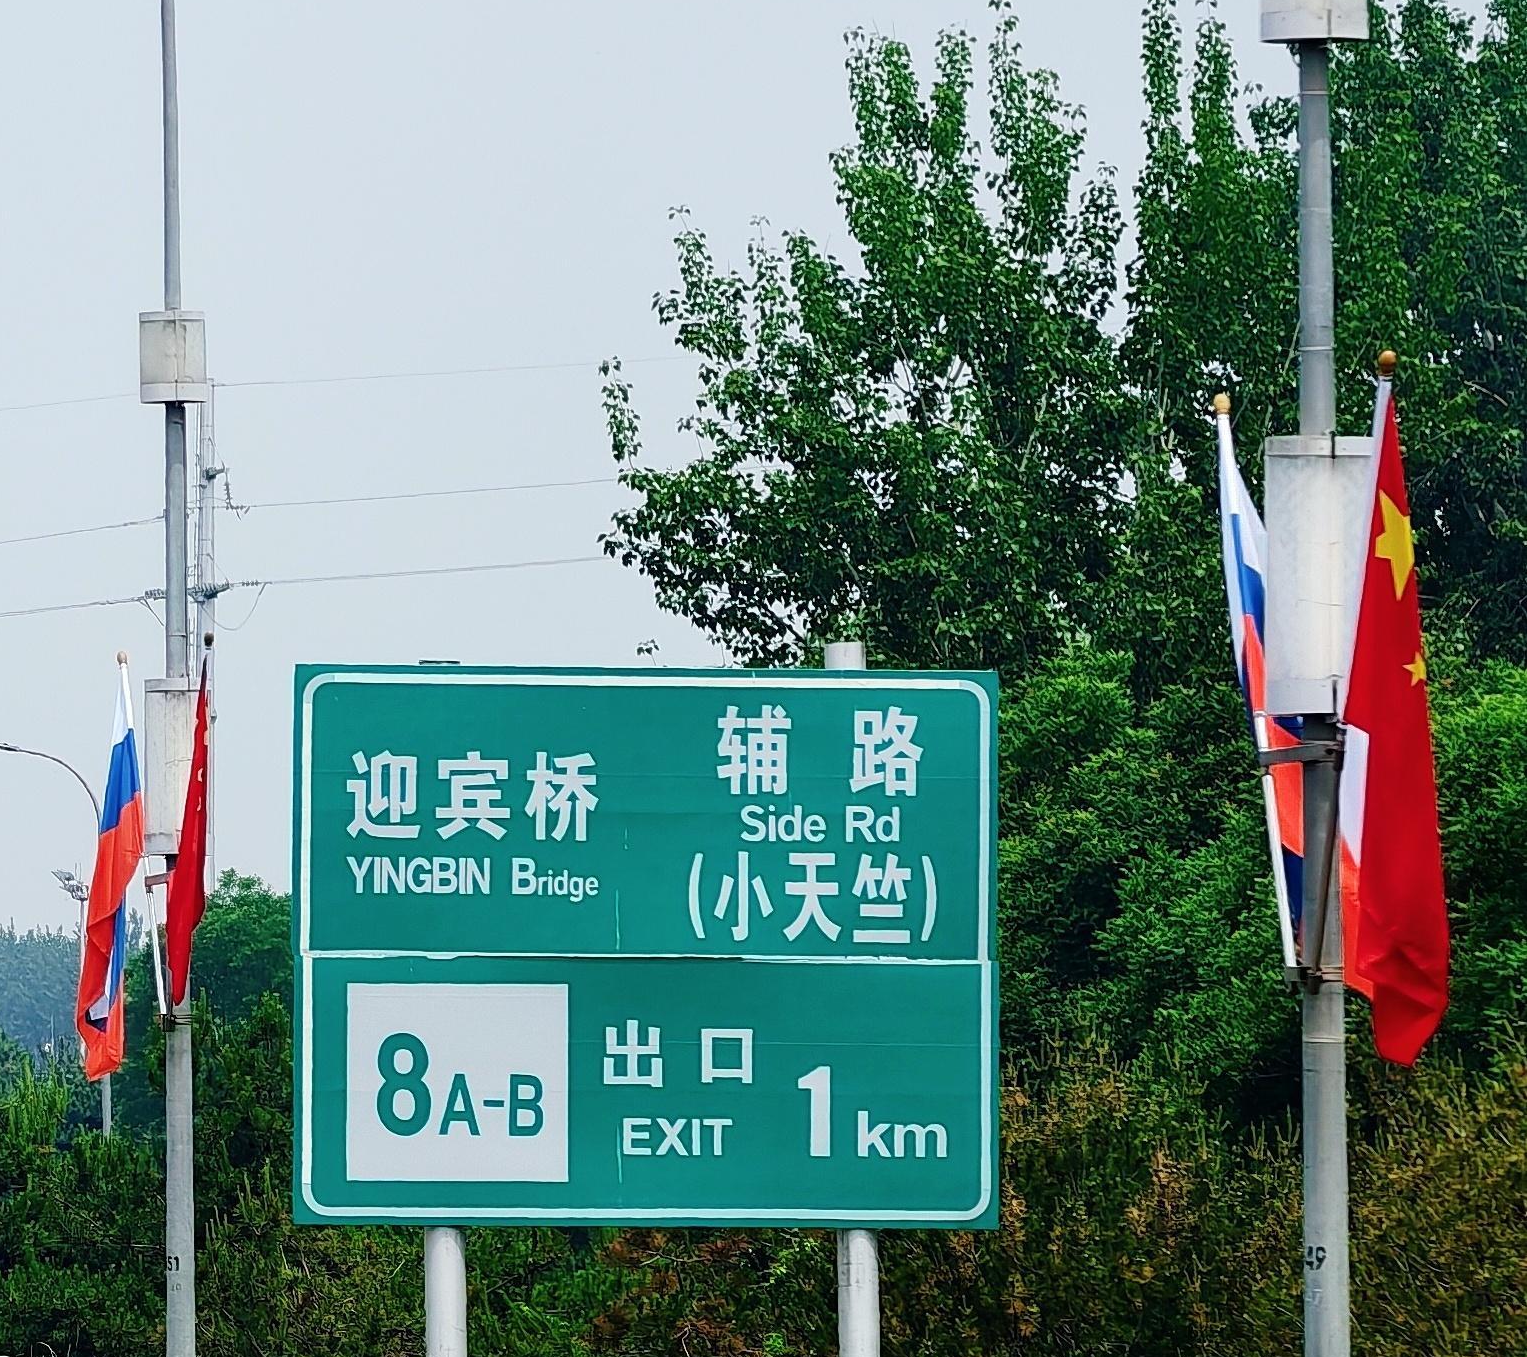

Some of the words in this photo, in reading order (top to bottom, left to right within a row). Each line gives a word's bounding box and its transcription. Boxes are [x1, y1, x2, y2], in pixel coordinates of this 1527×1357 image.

[717, 705, 924, 796] 辅路
[346, 750, 599, 842] 迎宾桥
[740, 805, 827, 842] Side
[845, 805, 901, 843] Rd
[346, 856, 491, 895] YINGBIN
[511, 857, 599, 903] Bridge
[376, 1032, 544, 1137] 8A-B
[603, 1020, 754, 1088] 出口
[622, 1118, 733, 1156] EXIT
[797, 1066, 831, 1158] 1
[857, 1110, 948, 1158] km
